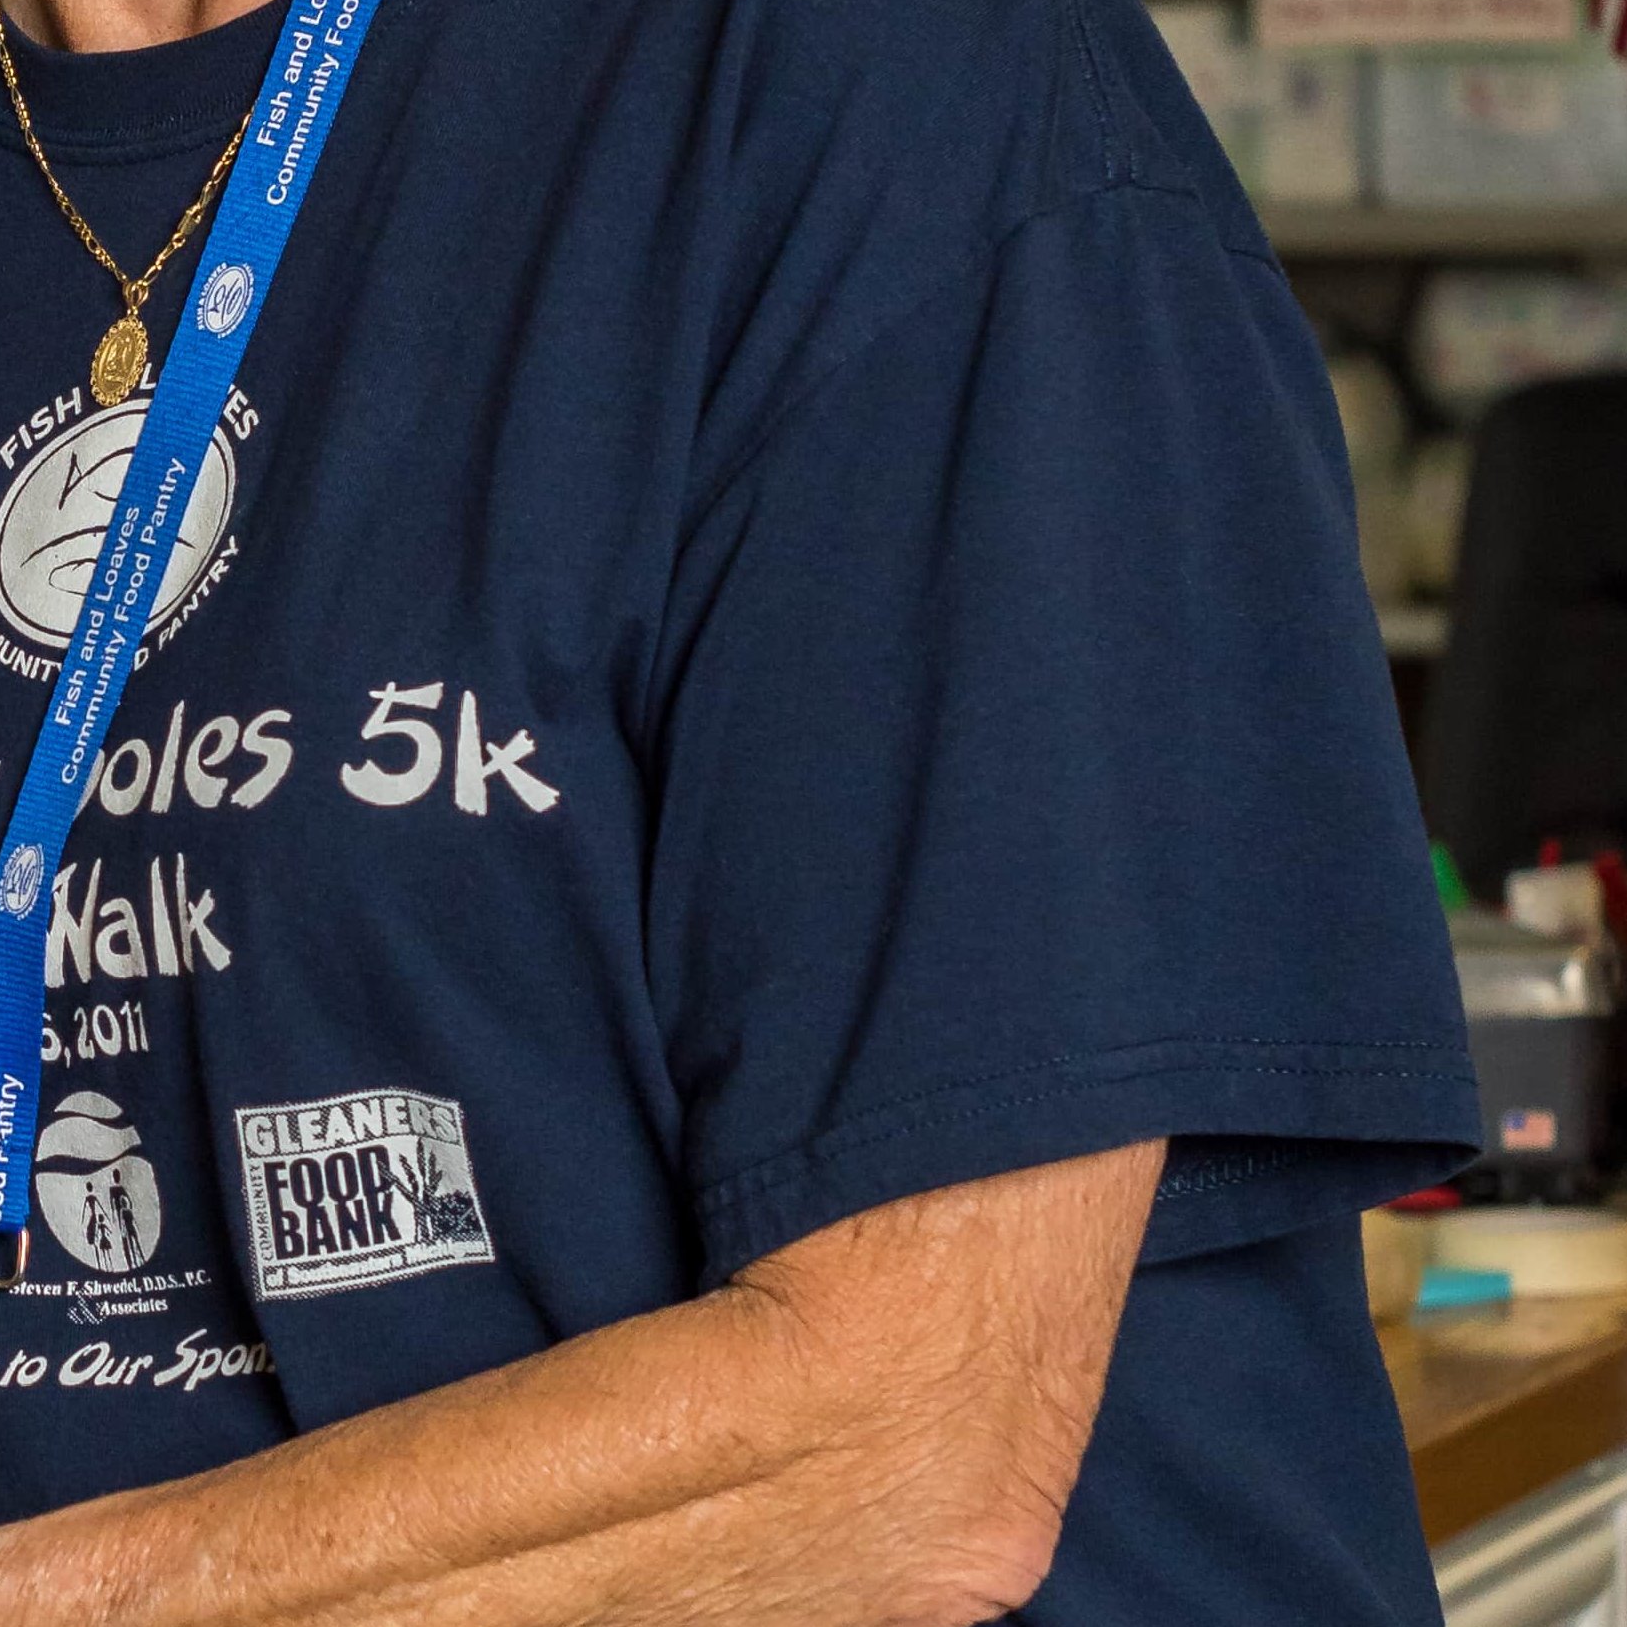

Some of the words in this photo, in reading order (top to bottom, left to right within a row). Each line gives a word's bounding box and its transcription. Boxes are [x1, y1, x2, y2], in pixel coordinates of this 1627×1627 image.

[257, 90, 293, 147] Fish
[283, 30, 314, 85] and
[265, 51, 341, 207] Community
[54, 669, 88, 727] Fish
[79, 608, 106, 663] and
[95, 504, 141, 604] Loaves
[60, 629, 128, 786] Community
[113, 551, 153, 624] Food
[139, 456, 187, 547] Pantry
[157, 535, 240, 651] PANTRY
[340, 680, 560, 816] 5k
[73, 1000, 149, 1060] 2011
[245, 1095, 459, 1156] GLEANERS
[263, 1144, 392, 1213] FOOD
[274, 1199, 402, 1261] BANK
[99, 1297, 169, 1316] Associates
[0, 1348, 48, 1388] to
[58, 1340, 153, 1387] Our
